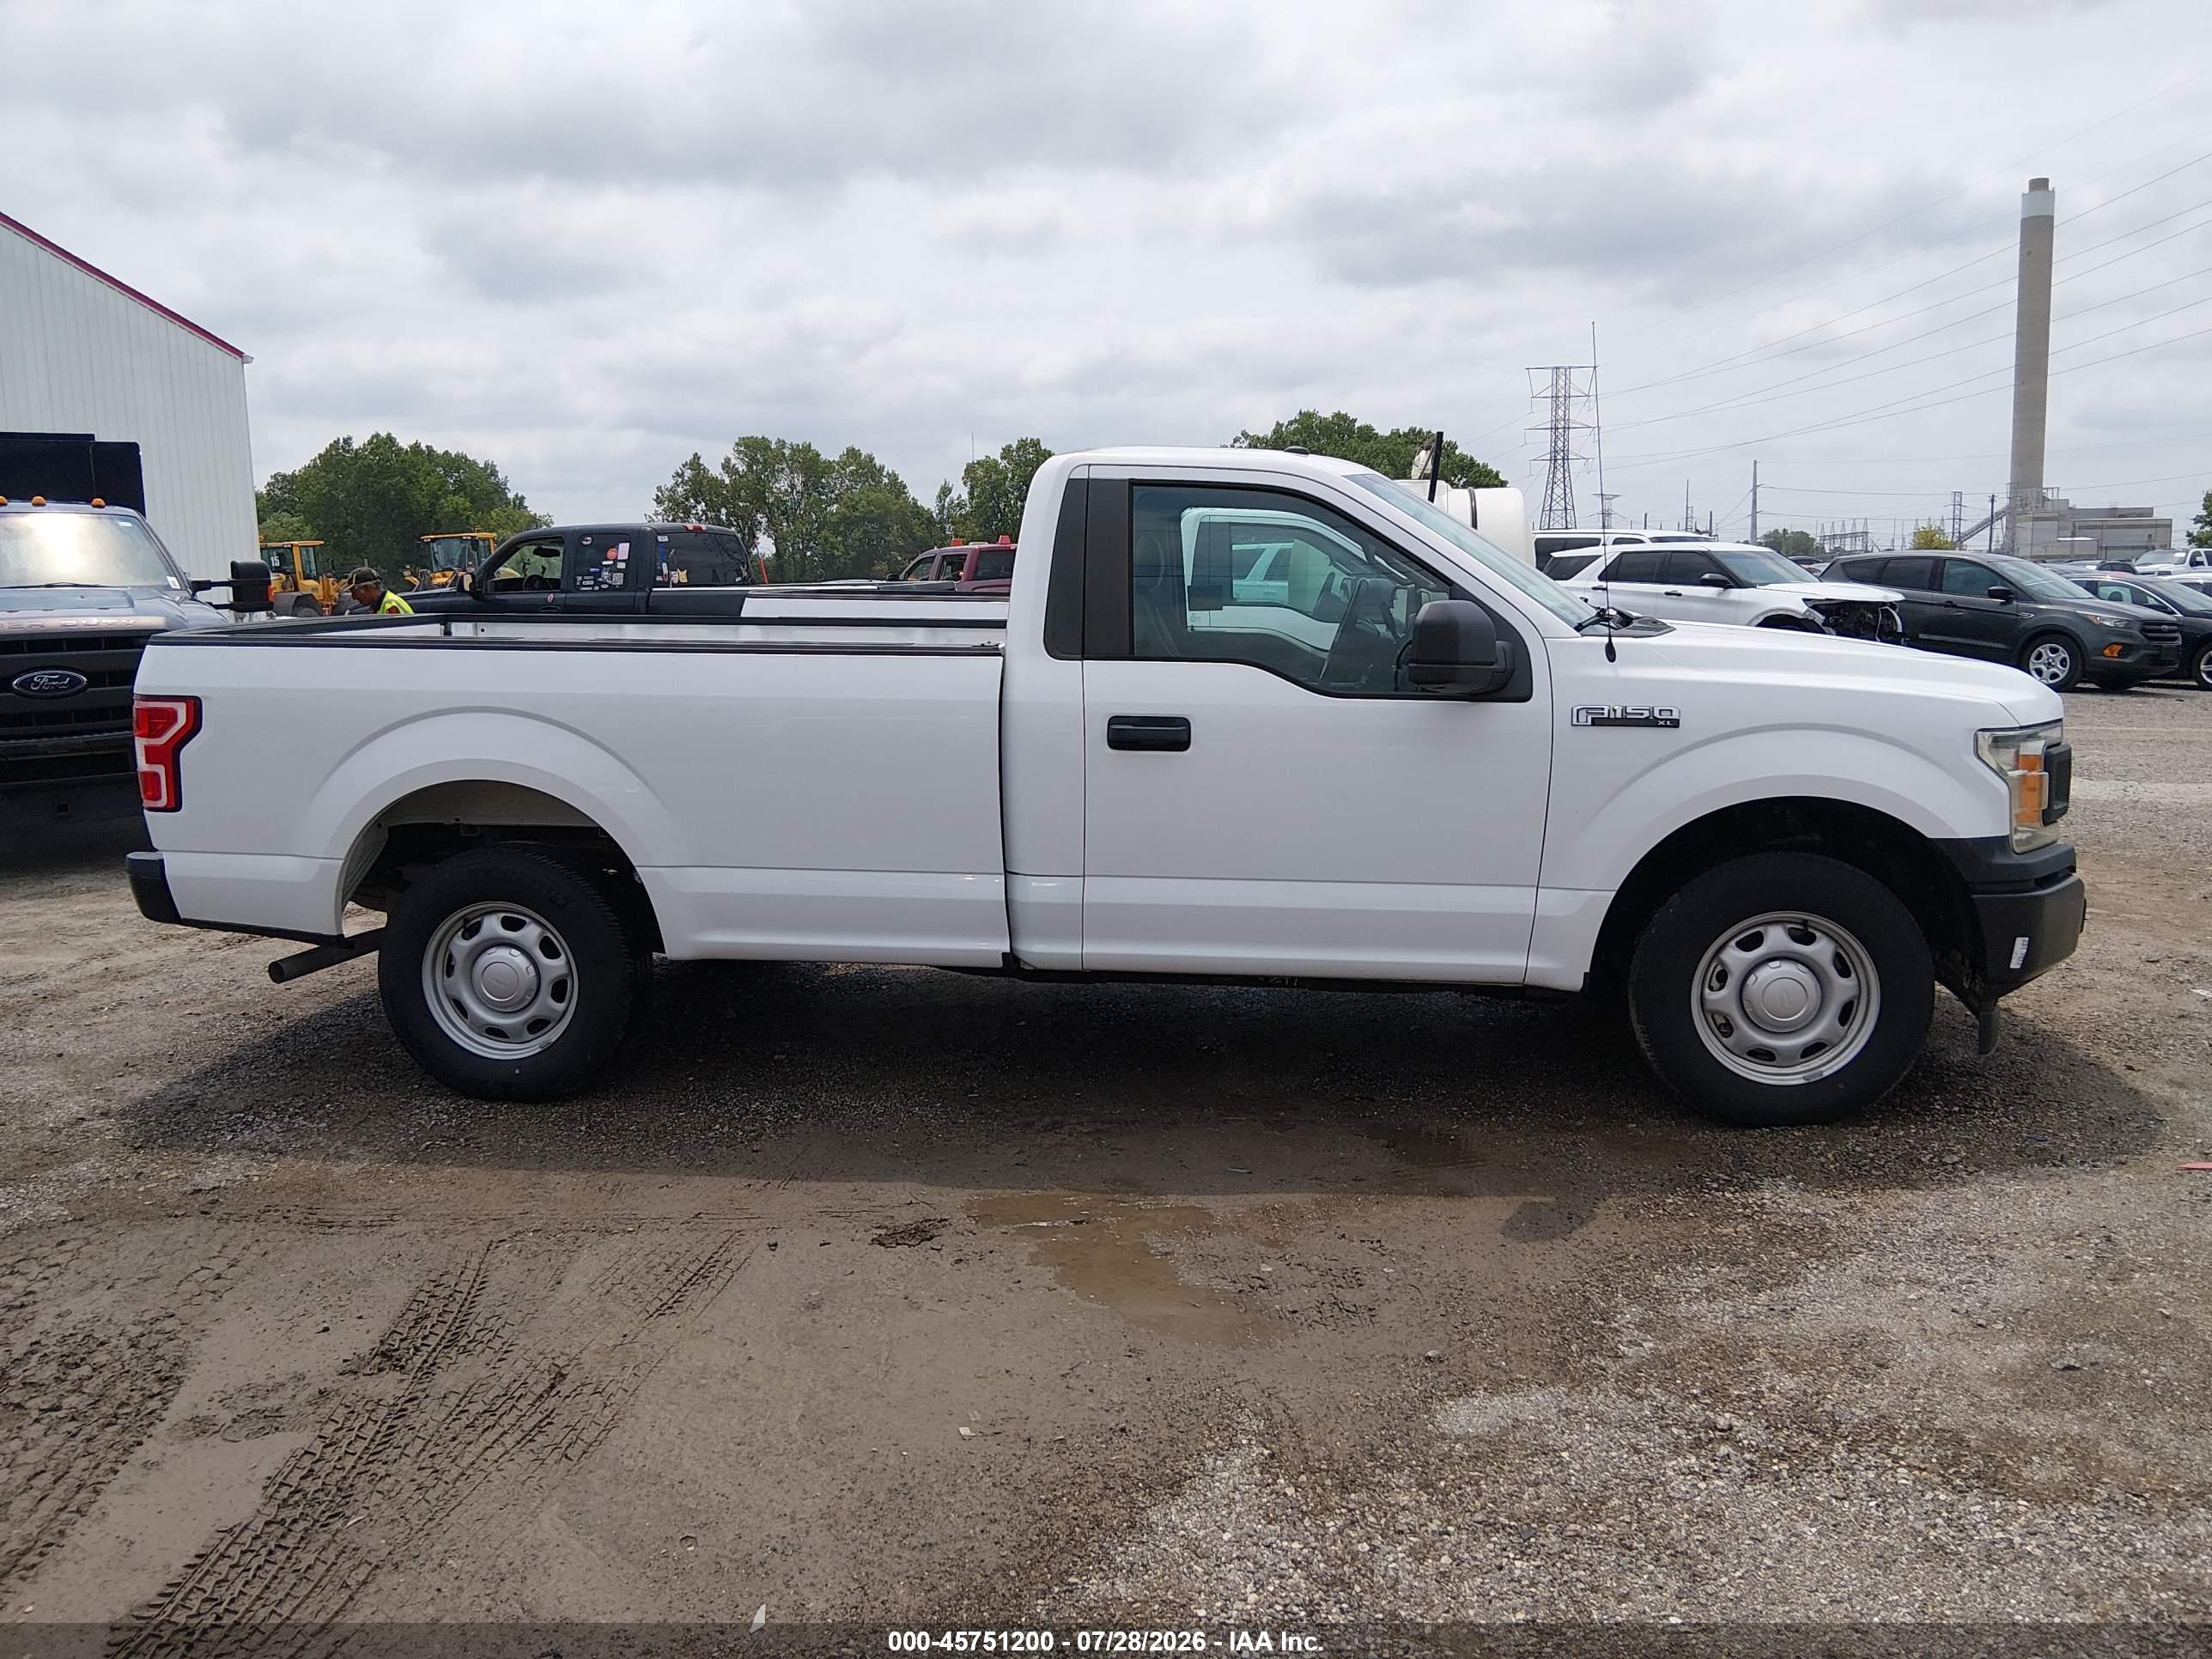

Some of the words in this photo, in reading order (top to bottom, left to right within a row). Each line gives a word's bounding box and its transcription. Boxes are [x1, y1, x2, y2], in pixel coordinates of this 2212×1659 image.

[270, 556, 281, 567] 15
[59, 617, 136, 628] DUTY
[30, 674, 70, 690] Ford
[1571, 704, 1680, 726] F150
